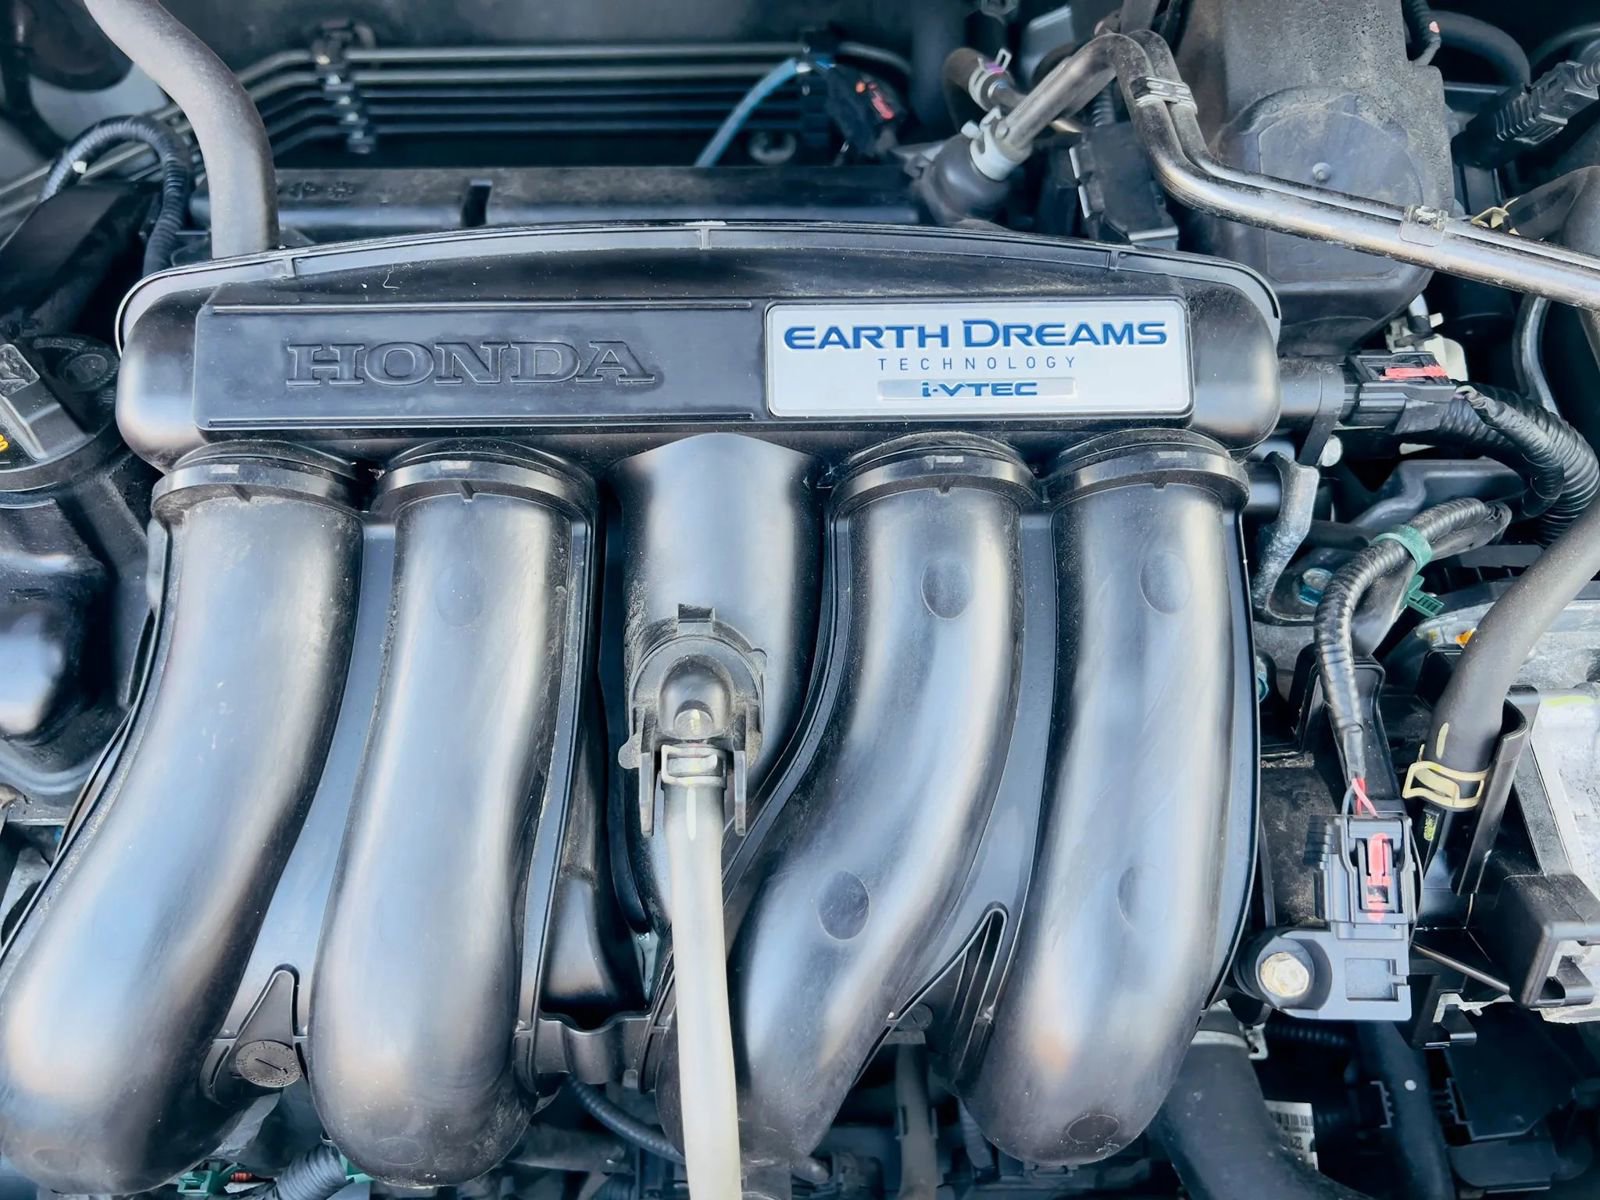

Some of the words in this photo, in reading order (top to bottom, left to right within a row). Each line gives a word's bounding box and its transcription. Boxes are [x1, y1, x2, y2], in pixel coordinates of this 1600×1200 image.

[783, 325, 949, 350] EARTH
[962, 320, 1168, 347] DREAMS
[286, 340, 656, 386] HONDA
[877, 356, 1076, 372] TECHNOLOGY
[921, 381, 1038, 398] i-VTEC
